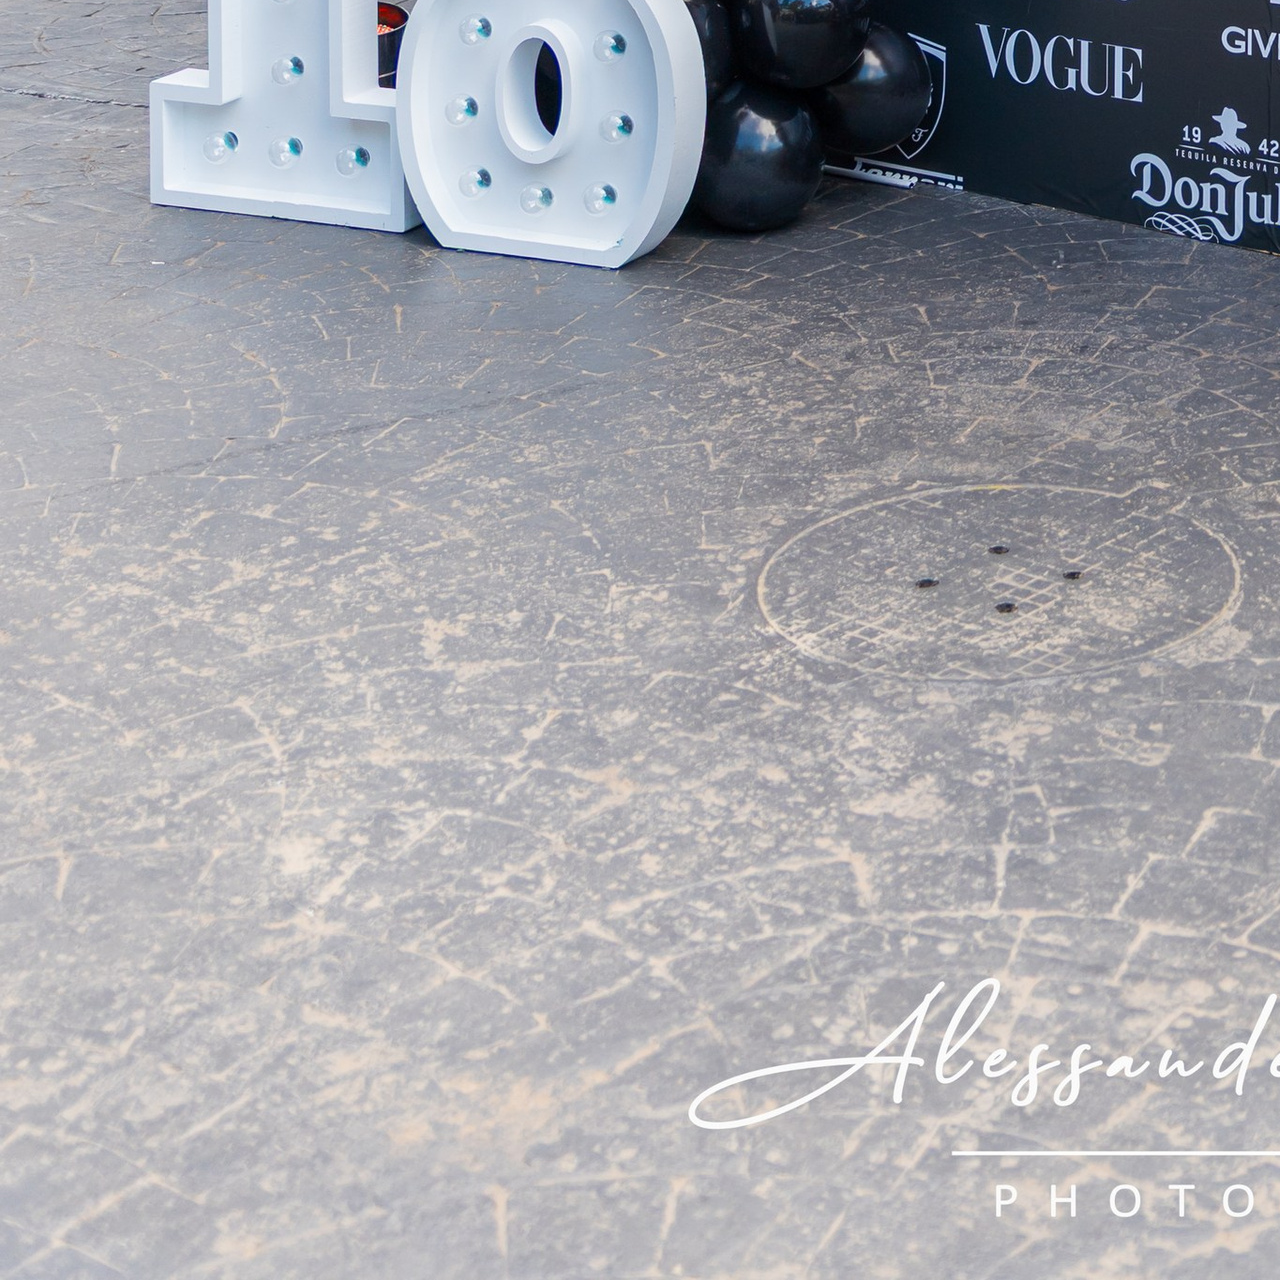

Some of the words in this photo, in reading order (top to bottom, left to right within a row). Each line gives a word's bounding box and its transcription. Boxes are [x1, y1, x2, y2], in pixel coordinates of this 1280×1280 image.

[976, 23, 1142, 102] VOGUE
[1181, 124, 1202, 144] 19
[1258, 138, 1280, 158] 42
[1175, 148, 1218, 164] TEQUILA
[1223, 157, 1268, 172] RESERVA
